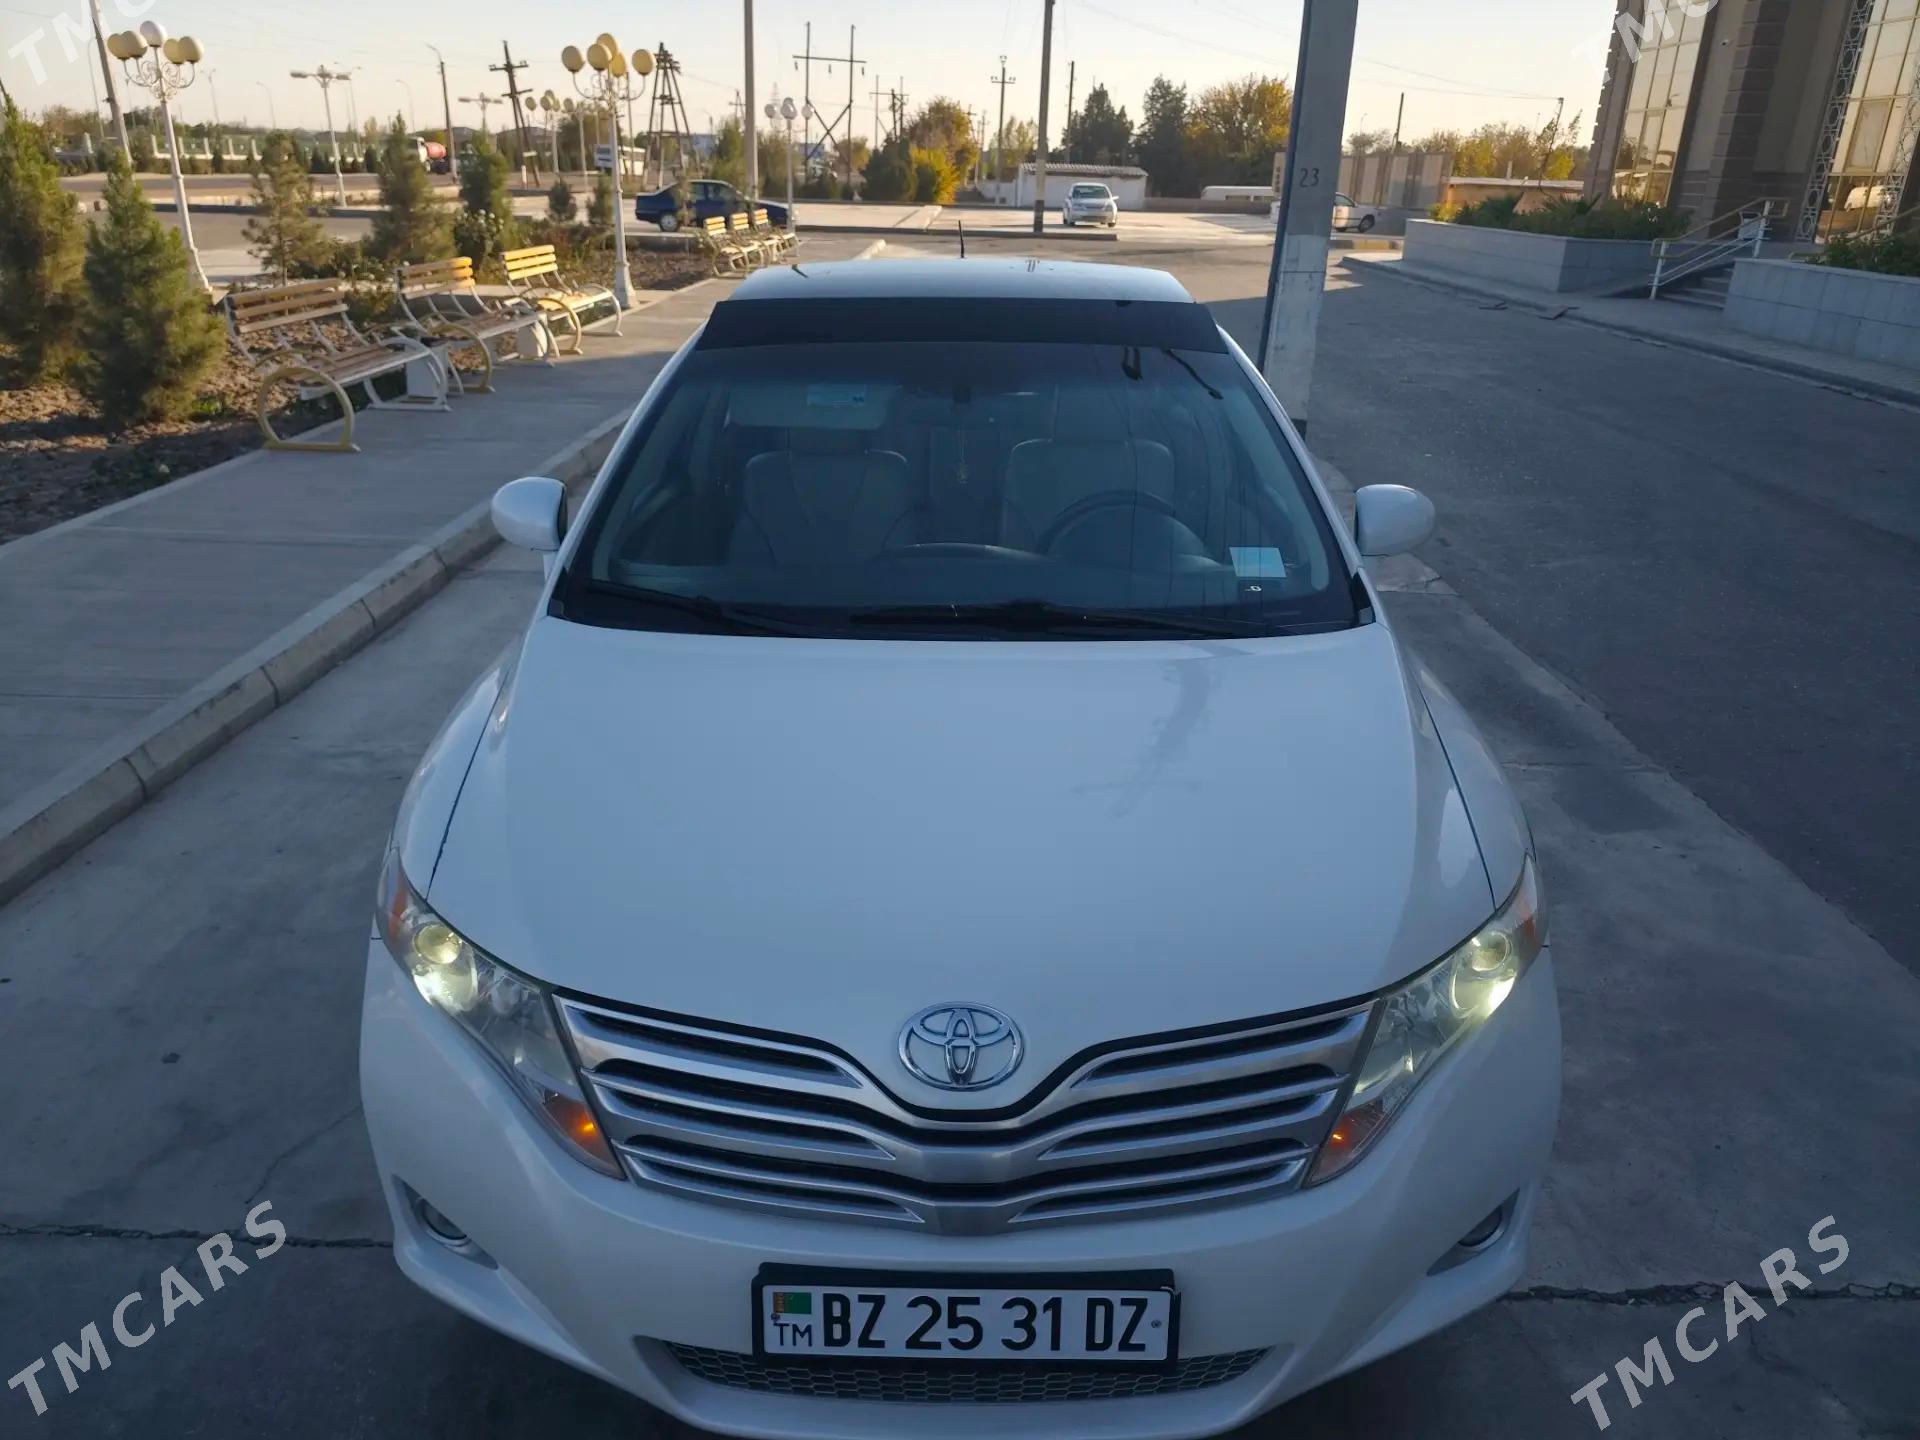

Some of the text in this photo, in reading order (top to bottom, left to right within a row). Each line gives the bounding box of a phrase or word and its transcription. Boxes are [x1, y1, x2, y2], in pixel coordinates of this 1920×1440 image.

[1299, 167, 1320, 188] 23
[822, 1293, 1148, 1352] BZ 25 31 DZ
[773, 1323, 813, 1347] TM
